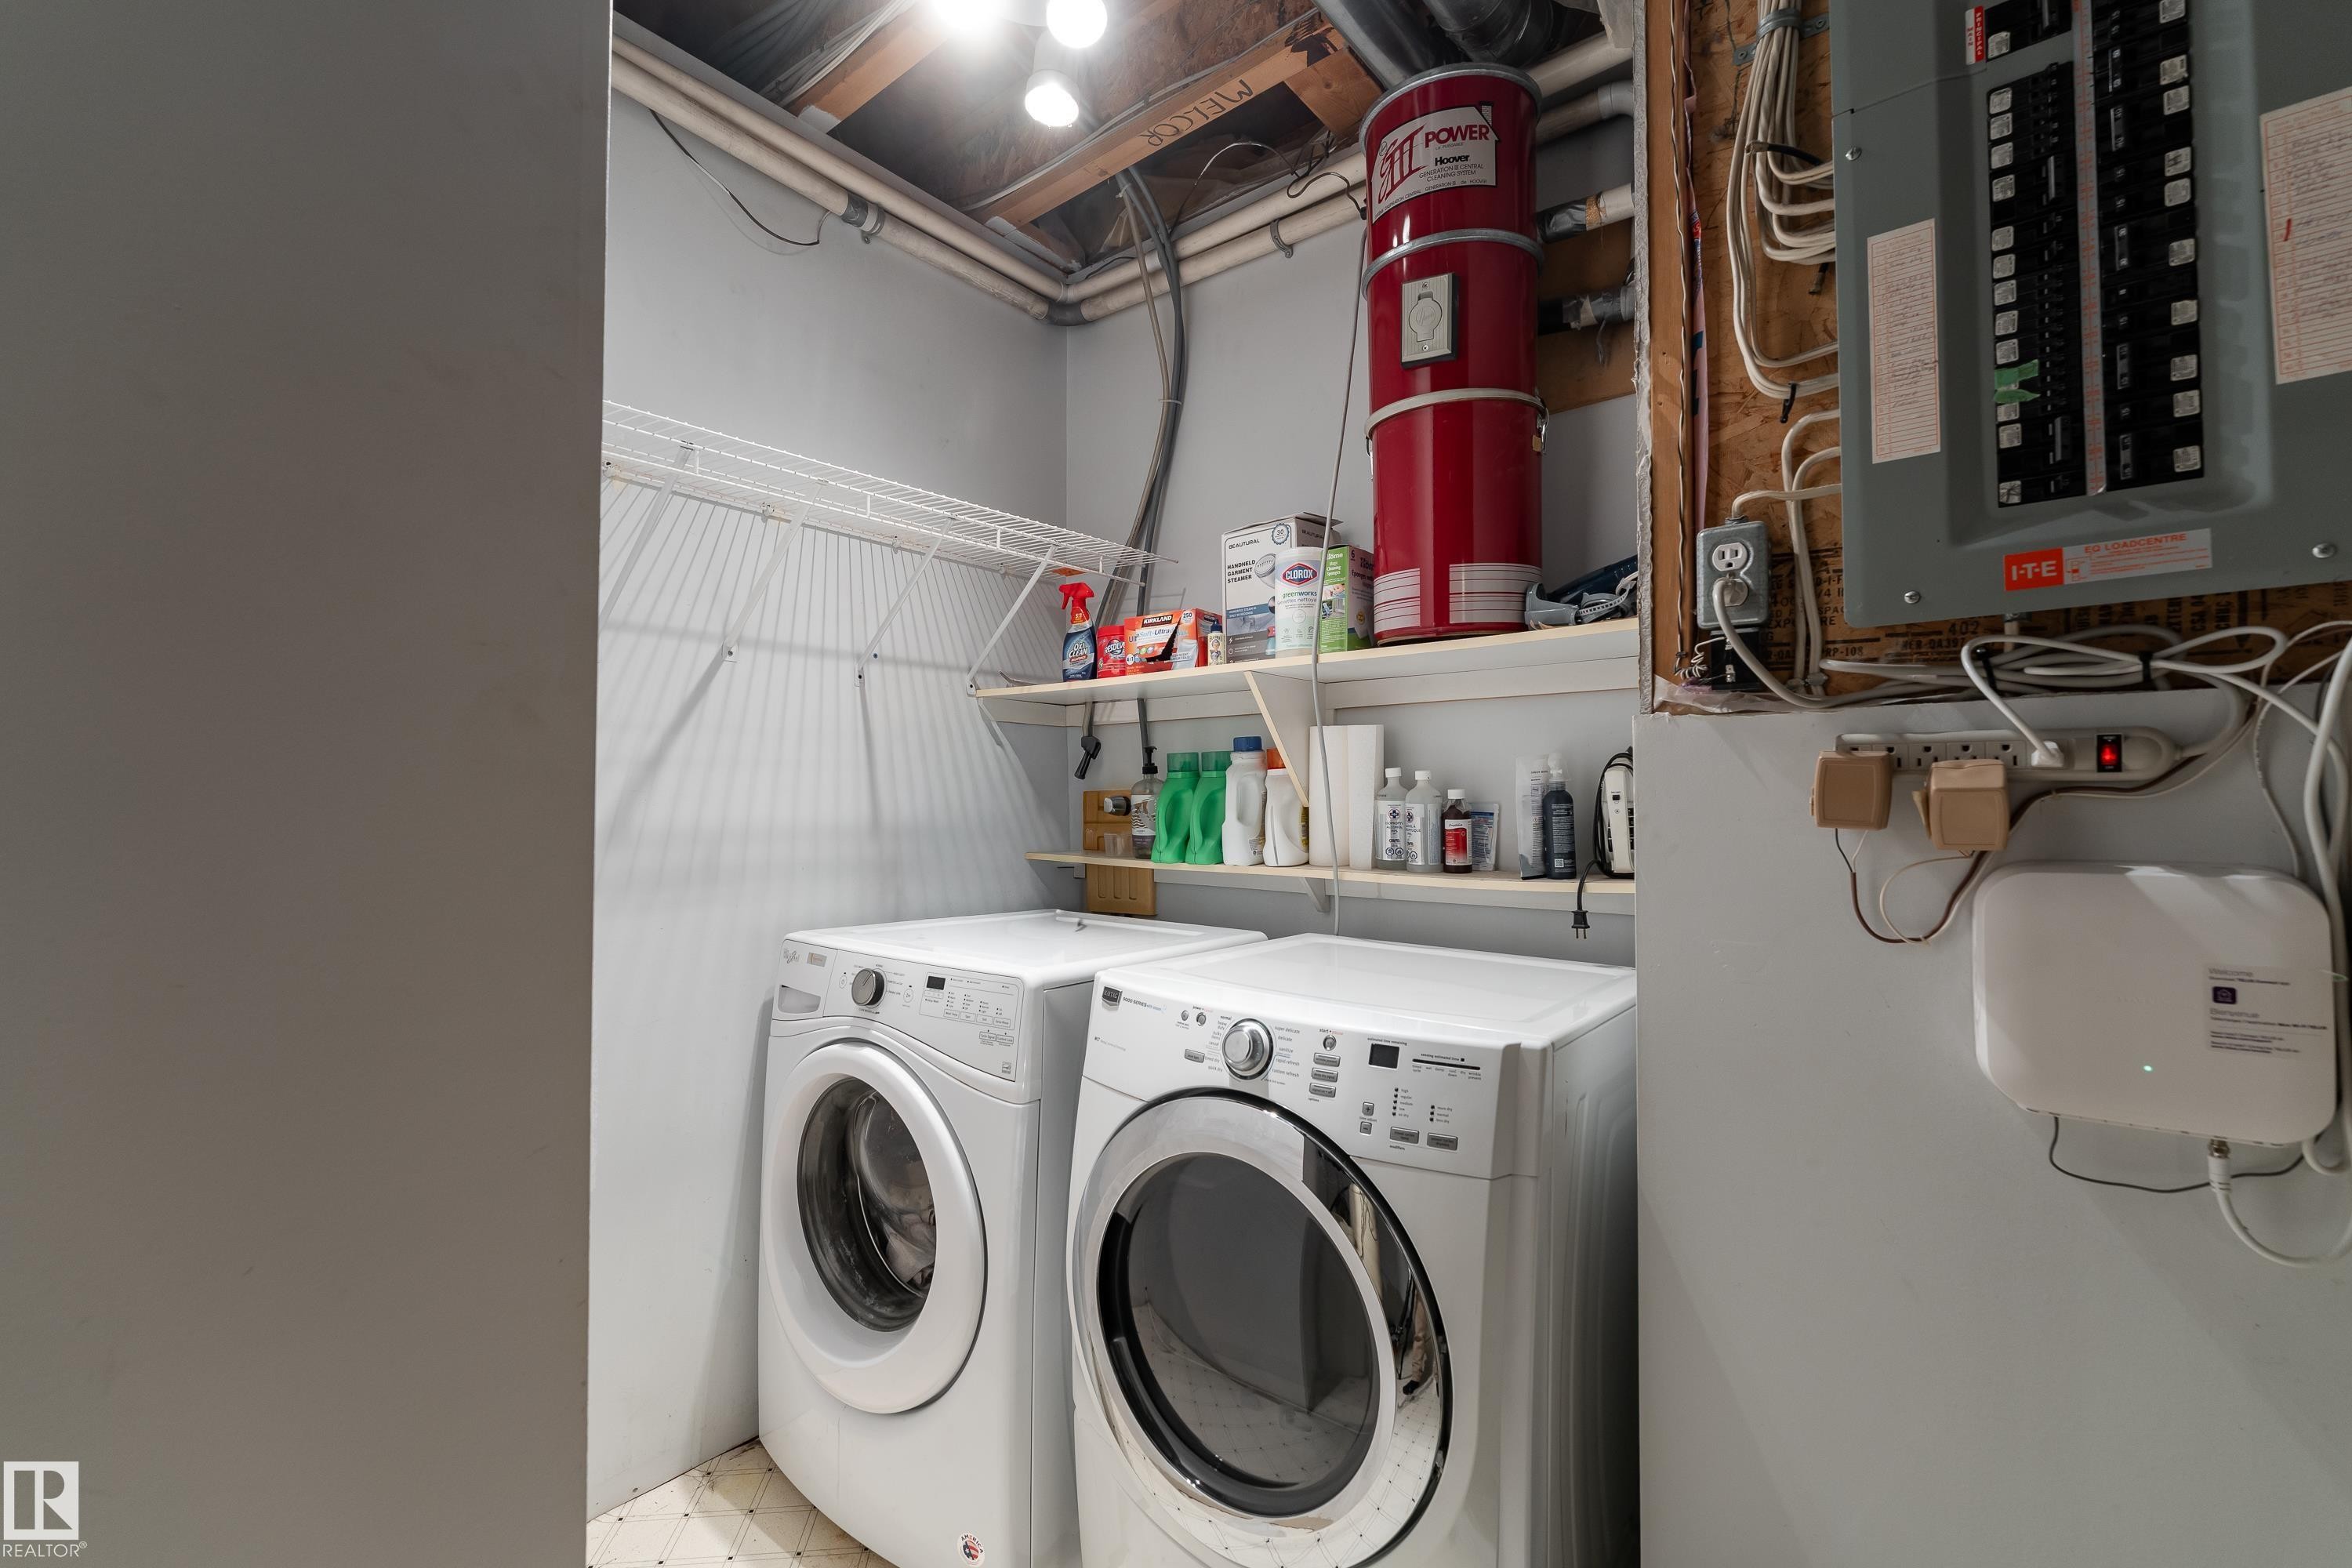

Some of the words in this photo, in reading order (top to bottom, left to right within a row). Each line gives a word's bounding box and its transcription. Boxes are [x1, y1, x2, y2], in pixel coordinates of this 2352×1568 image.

[1139, 78, 1254, 147] WELCOR
[1425, 124, 1490, 148] POWER
[1435, 154, 1470, 166] Hoover
[1426, 172, 1456, 182] CLEANING
[1229, 539, 1260, 549] BEAUTURAL
[2105, 533, 2187, 551] LOADCENTRE
[1351, 550, 1355, 558] 6
[1227, 560, 1255, 569] HANDHELD
[1227, 568, 1253, 577] GARMENT
[1286, 569, 1313, 579] CLOROX
[1227, 575, 1252, 583] STEAMER
[1282, 590, 1317, 599] greenworks
[1143, 615, 1172, 624] KIRKLAND
[1069, 648, 1087, 658] CLEAN
[2209, 968, 2254, 977] Welcome
[2210, 1008, 2260, 1018] Bienvenue
[961, 1534, 984, 1553] AMERICA
